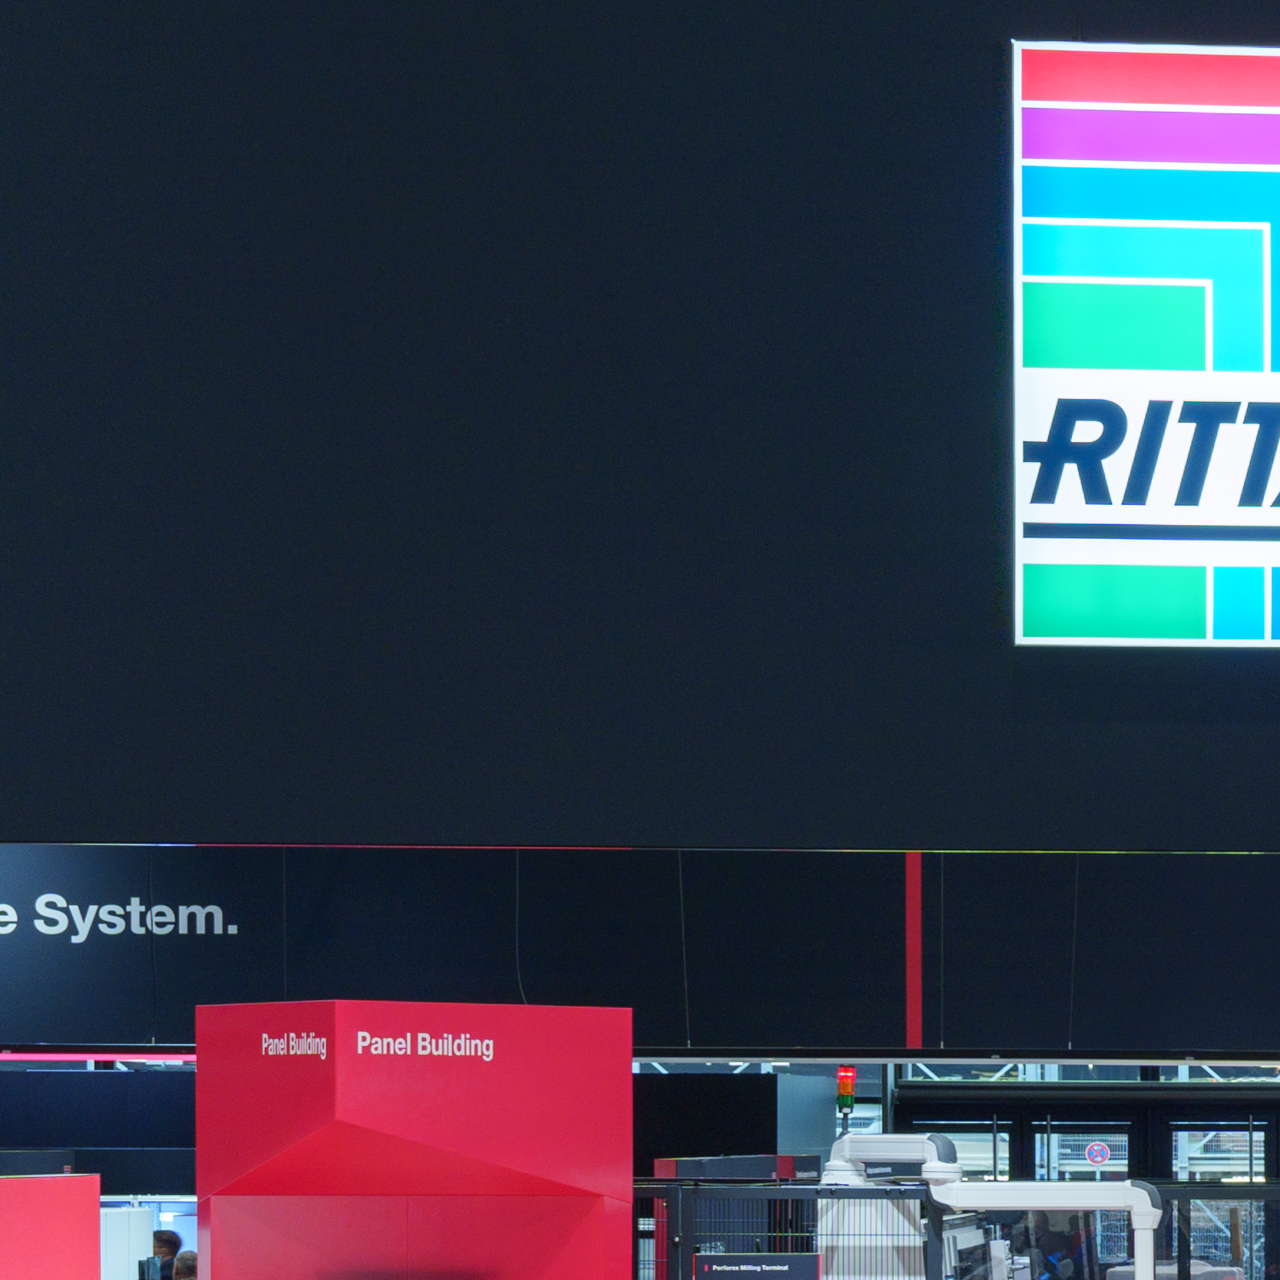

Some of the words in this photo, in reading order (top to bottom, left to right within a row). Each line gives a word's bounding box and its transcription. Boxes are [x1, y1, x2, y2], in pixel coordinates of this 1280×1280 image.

[33, 893, 238, 944] System.
[262, 1033, 287, 1056] Panel
[289, 1032, 327, 1060] Building
[357, 1031, 411, 1055] Panel
[417, 1033, 494, 1062] Building
